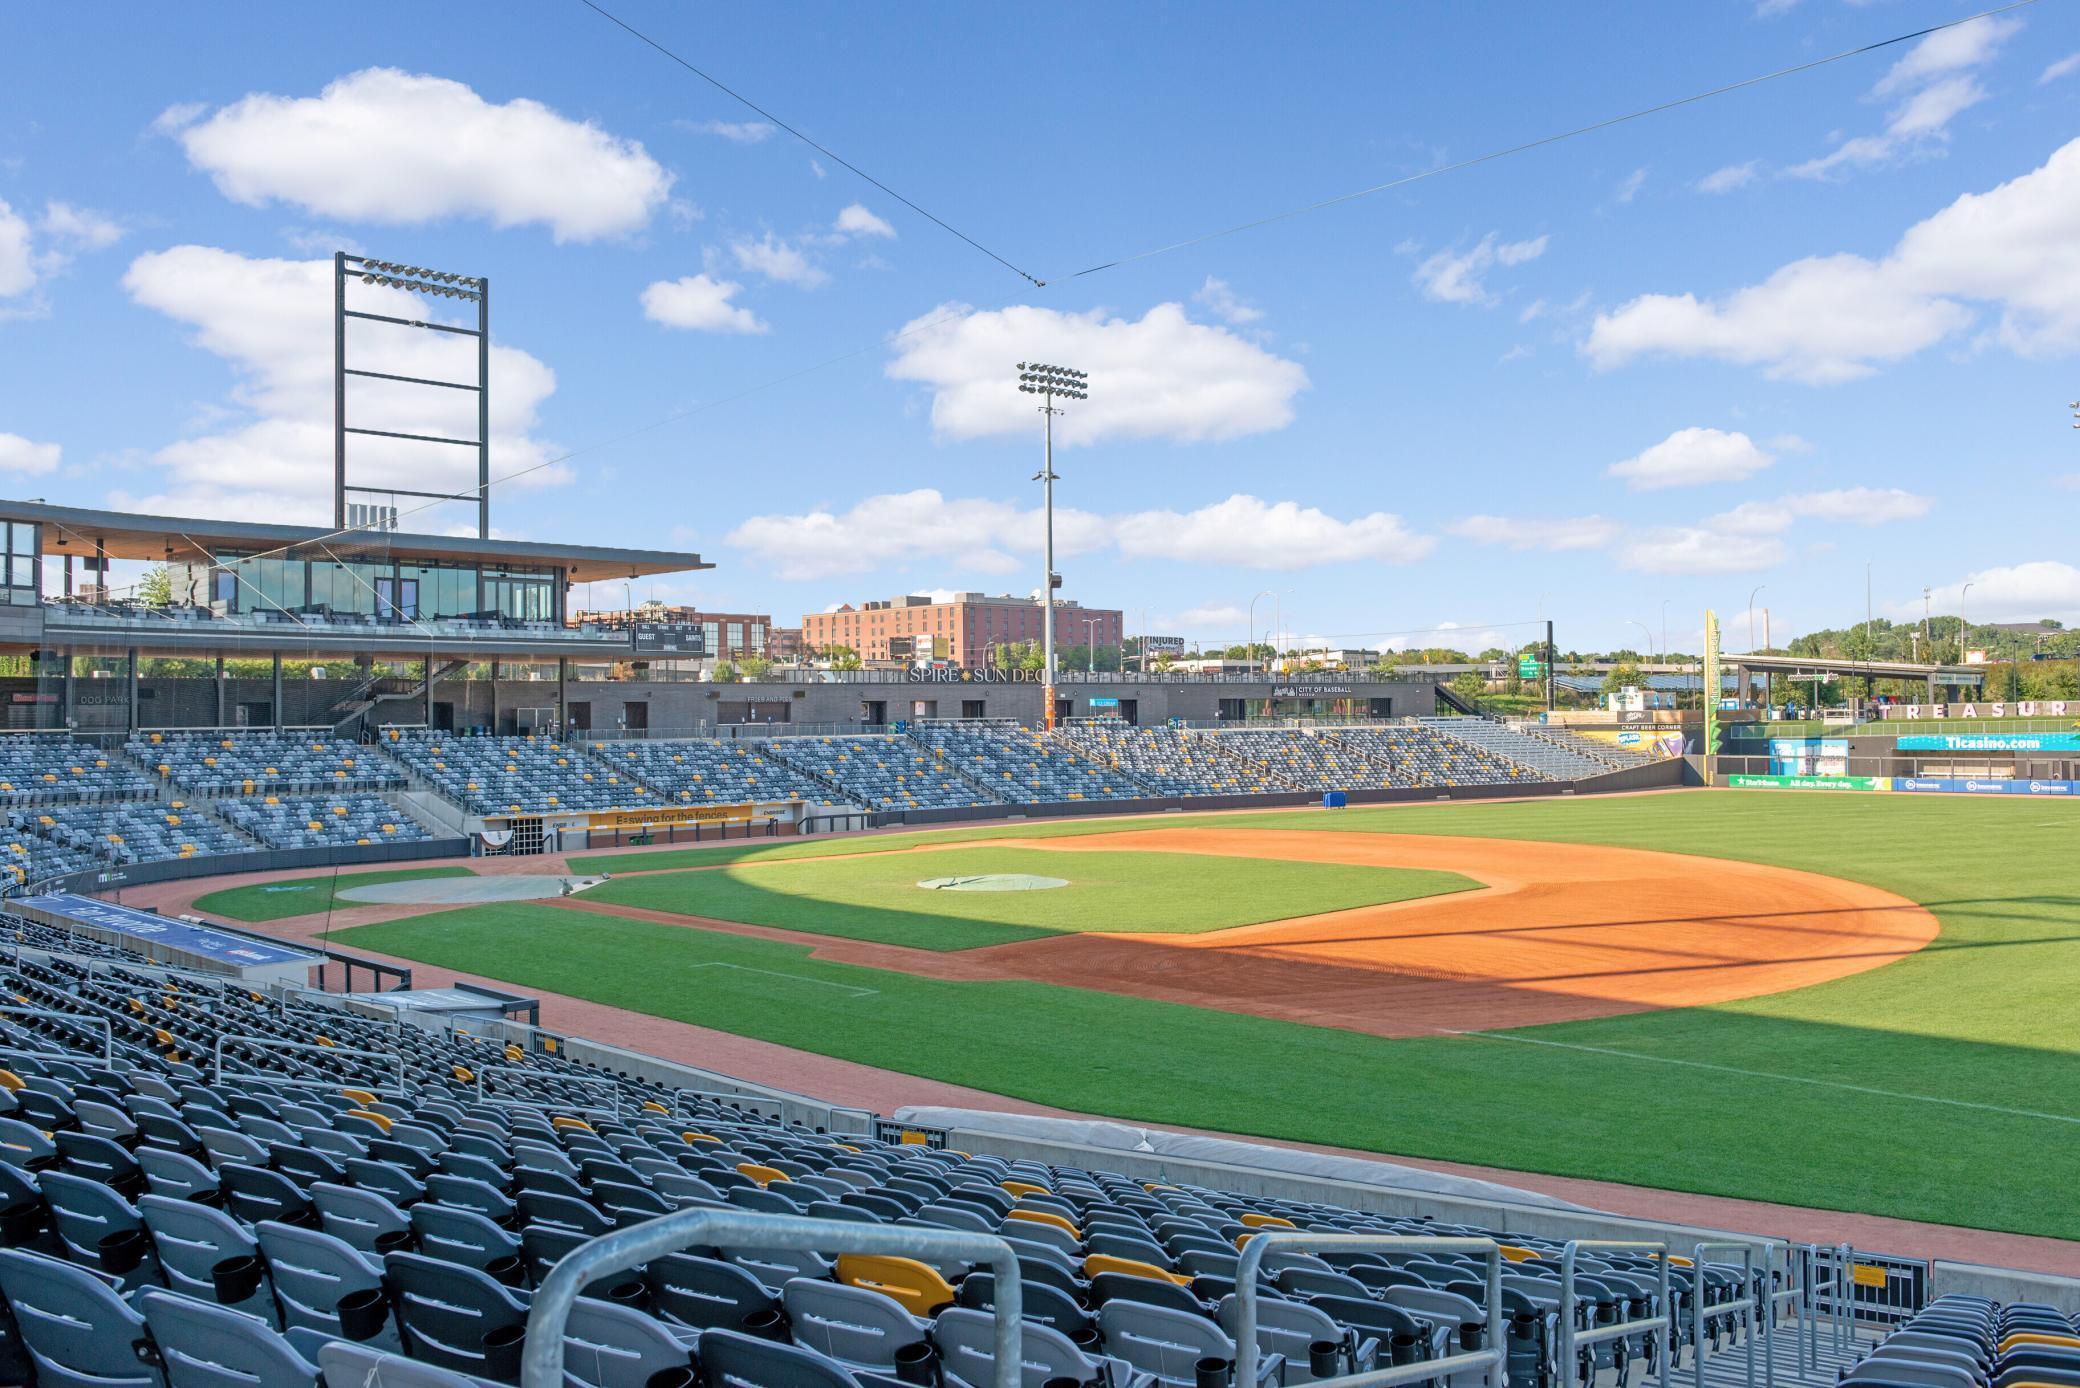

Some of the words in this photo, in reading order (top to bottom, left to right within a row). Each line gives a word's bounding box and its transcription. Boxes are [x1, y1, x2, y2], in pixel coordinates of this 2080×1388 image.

[1150, 636, 1184, 646] INJURED
[910, 668, 960, 682] SPIRE
[973, 668, 1007, 682] SUN
[1012, 668, 1046, 682] DEC
[80, 696, 101, 704] DOG
[105, 696, 130, 704] PARK
[661, 813, 675, 822] for
[677, 812, 693, 821] the
[695, 811, 728, 820] fences
